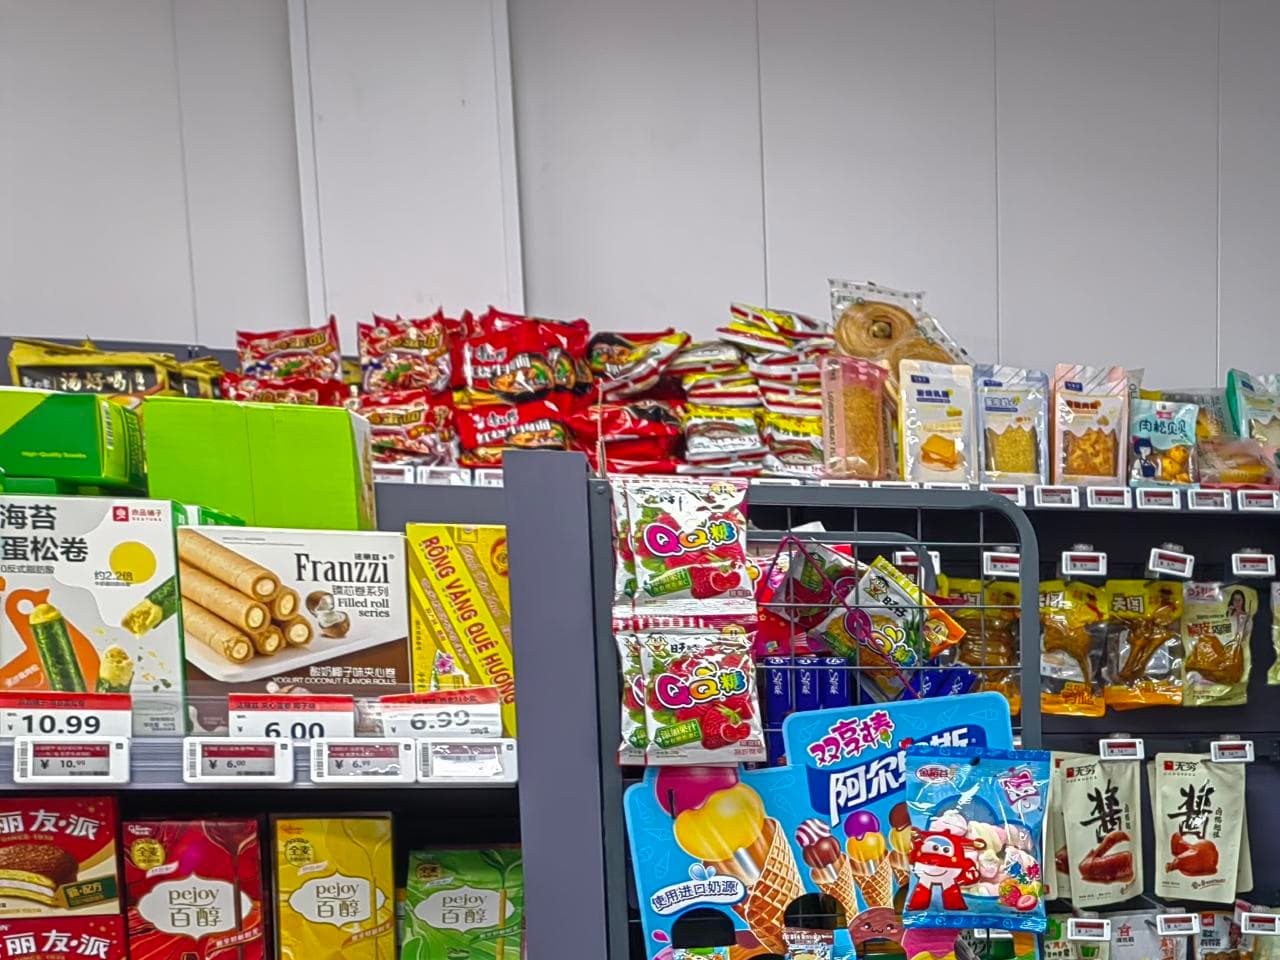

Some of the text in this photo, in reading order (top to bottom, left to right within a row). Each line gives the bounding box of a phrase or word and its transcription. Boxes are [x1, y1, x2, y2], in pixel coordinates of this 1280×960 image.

[1139, 419, 1187, 436] 肉松贝贝
[0, 503, 57, 531] 海苔
[1, 536, 88, 562] 蛋松卷
[94, 571, 133, 581] 约2.2倍
[296, 553, 390, 583] Franzzi
[338, 598, 389, 608] Filled roll
[359, 609, 390, 618] series
[304, 677, 341, 685] COCONUT
[343, 677, 370, 685] FLAVOR
[371, 677, 396, 685] ROLLS
[656, 669, 748, 708] QQ糖
[22, 715, 100, 734] 10.99
[265, 721, 325, 738] 6.00
[808, 710, 895, 768] 双享棒
[169, 886, 220, 906] pejoy
[316, 882, 360, 898] pejoy
[317, 899, 361, 918] 百醇
[442, 894, 488, 908] pejoy
[169, 906, 222, 928] 百醇
[442, 907, 487, 925] 百醇
[0, 928, 111, 960] 丽友·派
